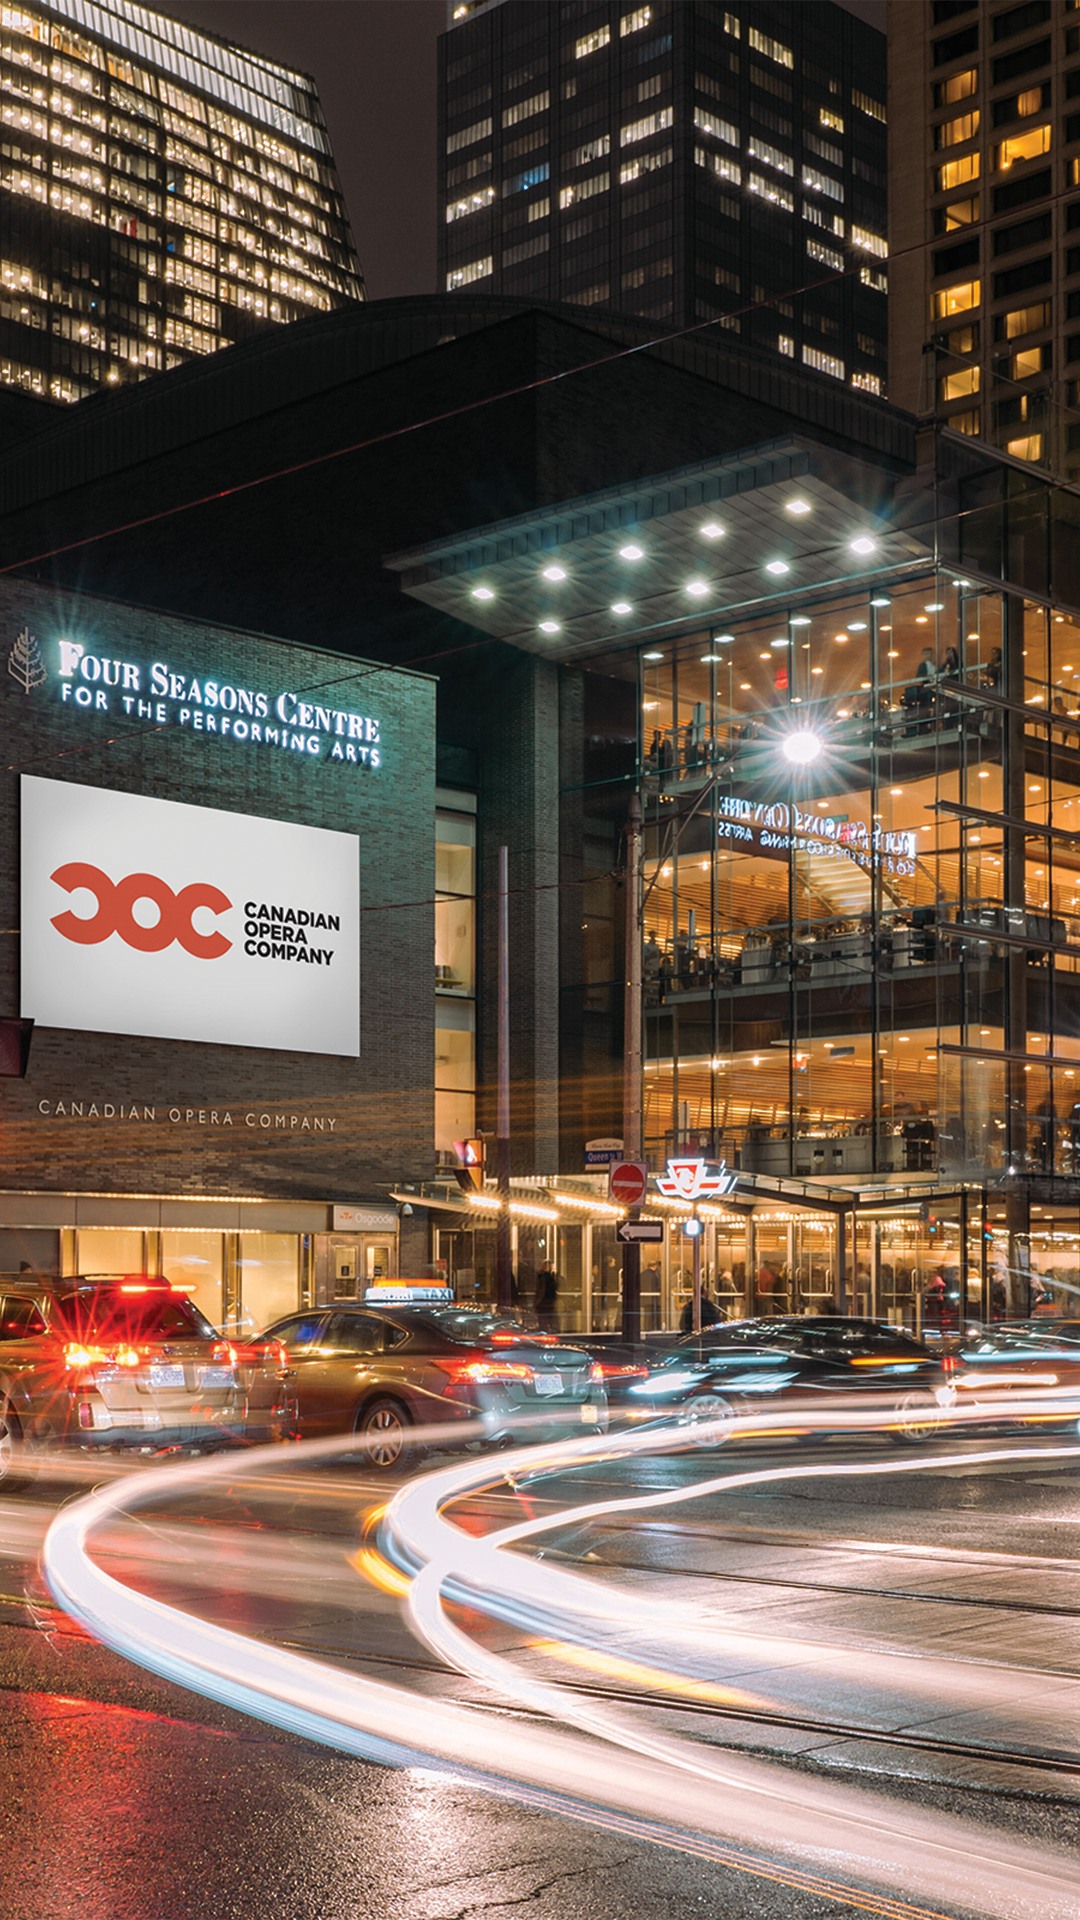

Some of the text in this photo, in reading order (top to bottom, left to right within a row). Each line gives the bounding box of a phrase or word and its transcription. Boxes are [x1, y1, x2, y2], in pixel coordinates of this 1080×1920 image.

[58, 640, 380, 743] FOUR SEASONS CENTRE
[62, 683, 381, 767] FOR THE PERFORMING ARTS
[244, 901, 340, 931] CANADIAN
[244, 920, 308, 945] OPERA
[244, 940, 334, 966] COMPANY
[38, 1099, 337, 1131] CANADIAN OPERA COMPANY
[588, 1152, 609, 1162] Queen
[355, 1212, 394, 1225] Osgoode
[422, 1288, 452, 1299] TAXI
